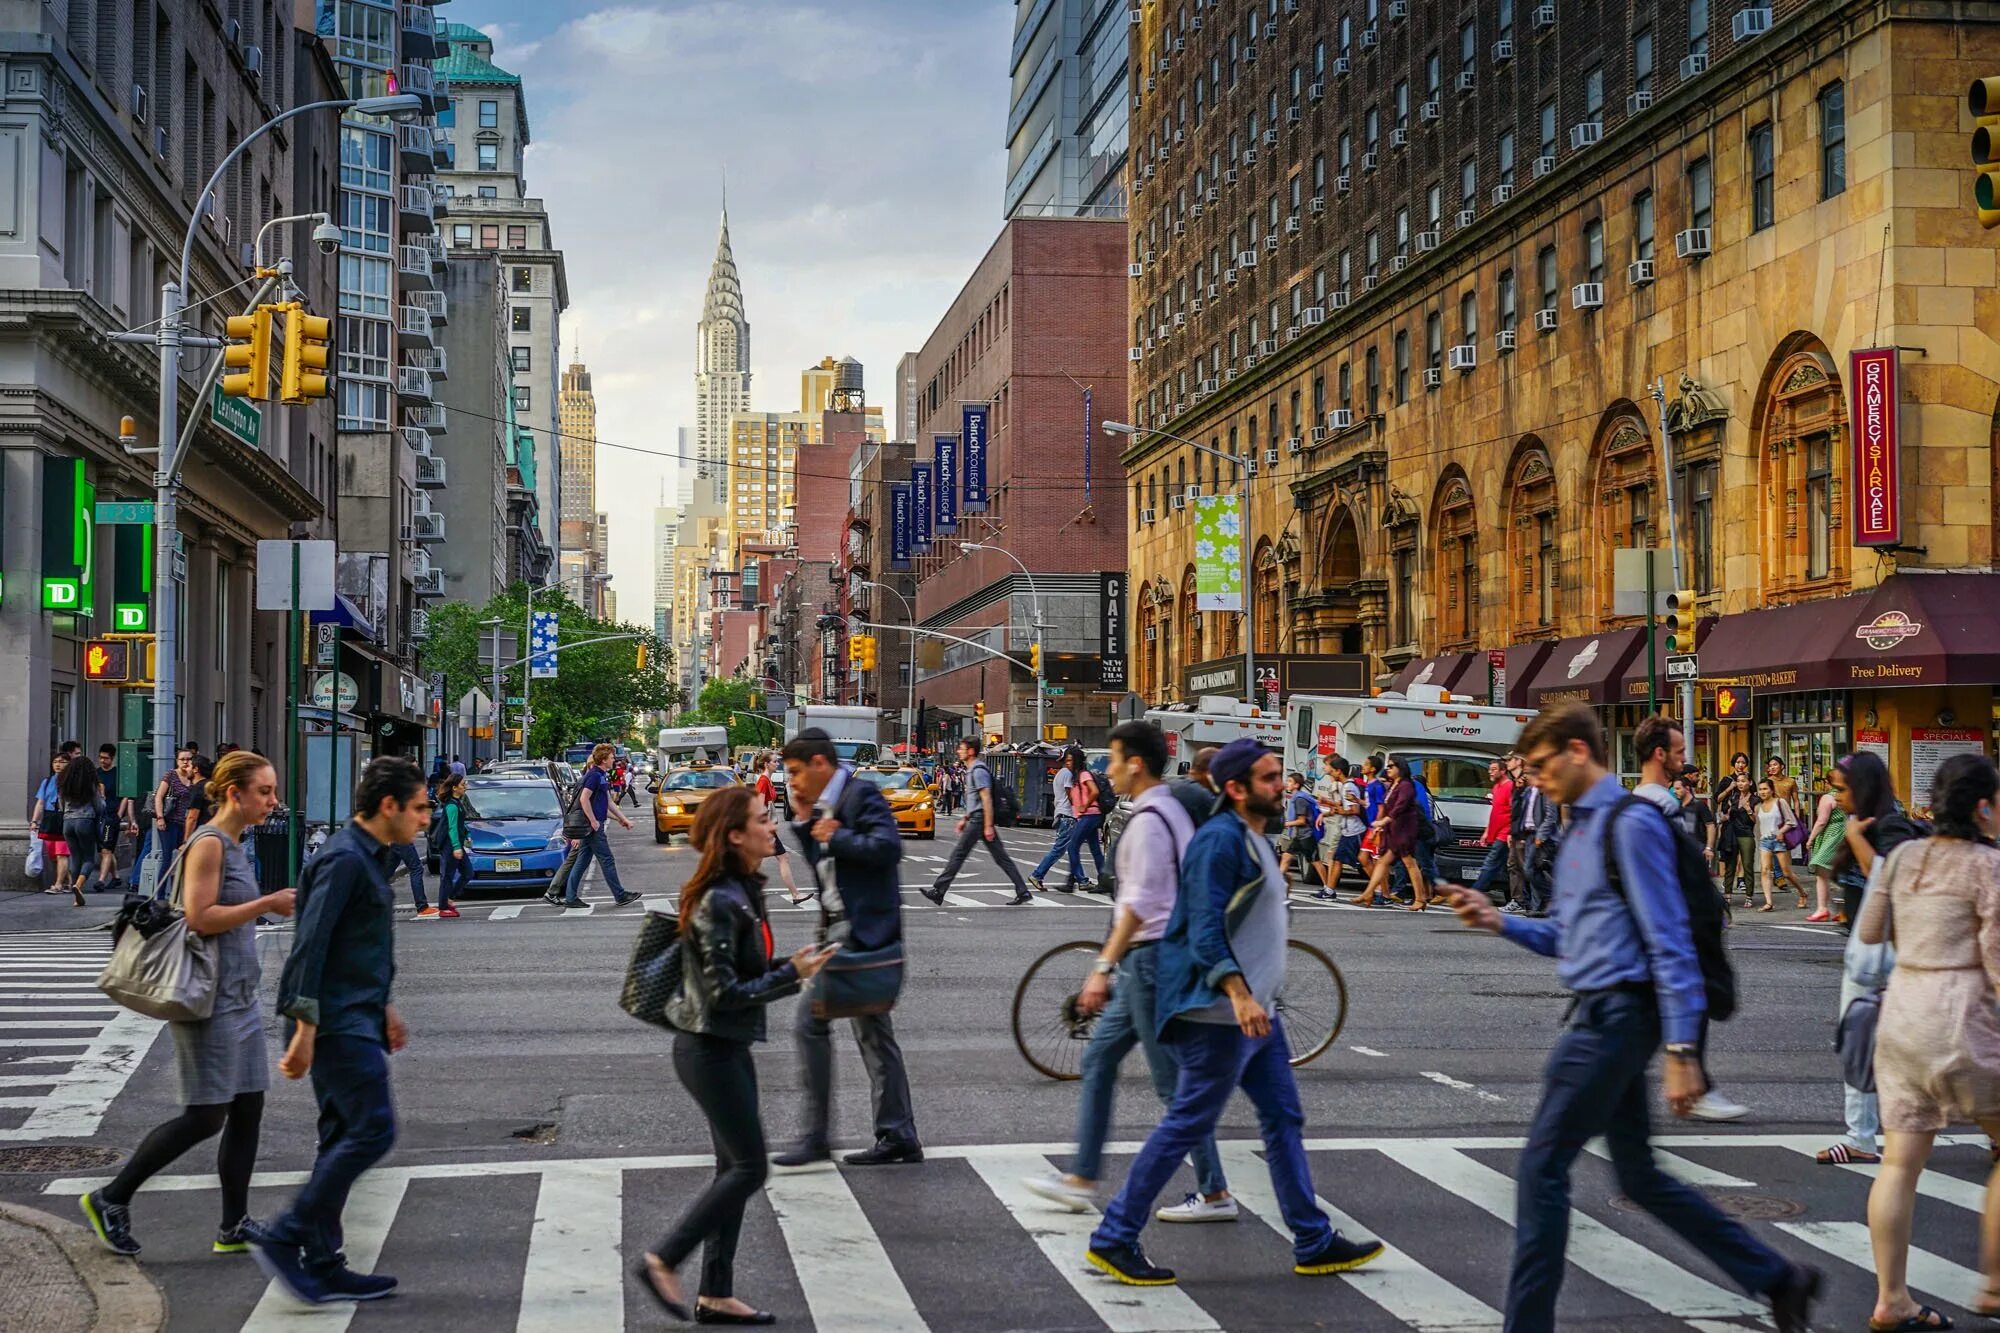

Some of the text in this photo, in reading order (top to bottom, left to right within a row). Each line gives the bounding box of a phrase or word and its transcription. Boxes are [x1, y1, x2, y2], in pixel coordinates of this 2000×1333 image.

[217, 393, 256, 438] Lexington Av
[114, 505, 137, 521] 23
[139, 505, 151, 514] ST
[46, 584, 75, 603] TD
[118, 608, 143, 625] TD
[1107, 579, 1119, 654] CAFE
[1670, 662, 1693, 673] ONE WAY
[1851, 664, 1922, 678] Free Delivery
[1256, 667, 1276, 683] 23
[1771, 670, 1797, 684] BAKERY
[315, 693, 356, 702] Gyro Pizza
[1580, 688, 1590, 701] BAR
[1445, 725, 1481, 736] verizon
[1923, 733, 1972, 741] SPECIALS
[1256, 734, 1283, 742] verizon
